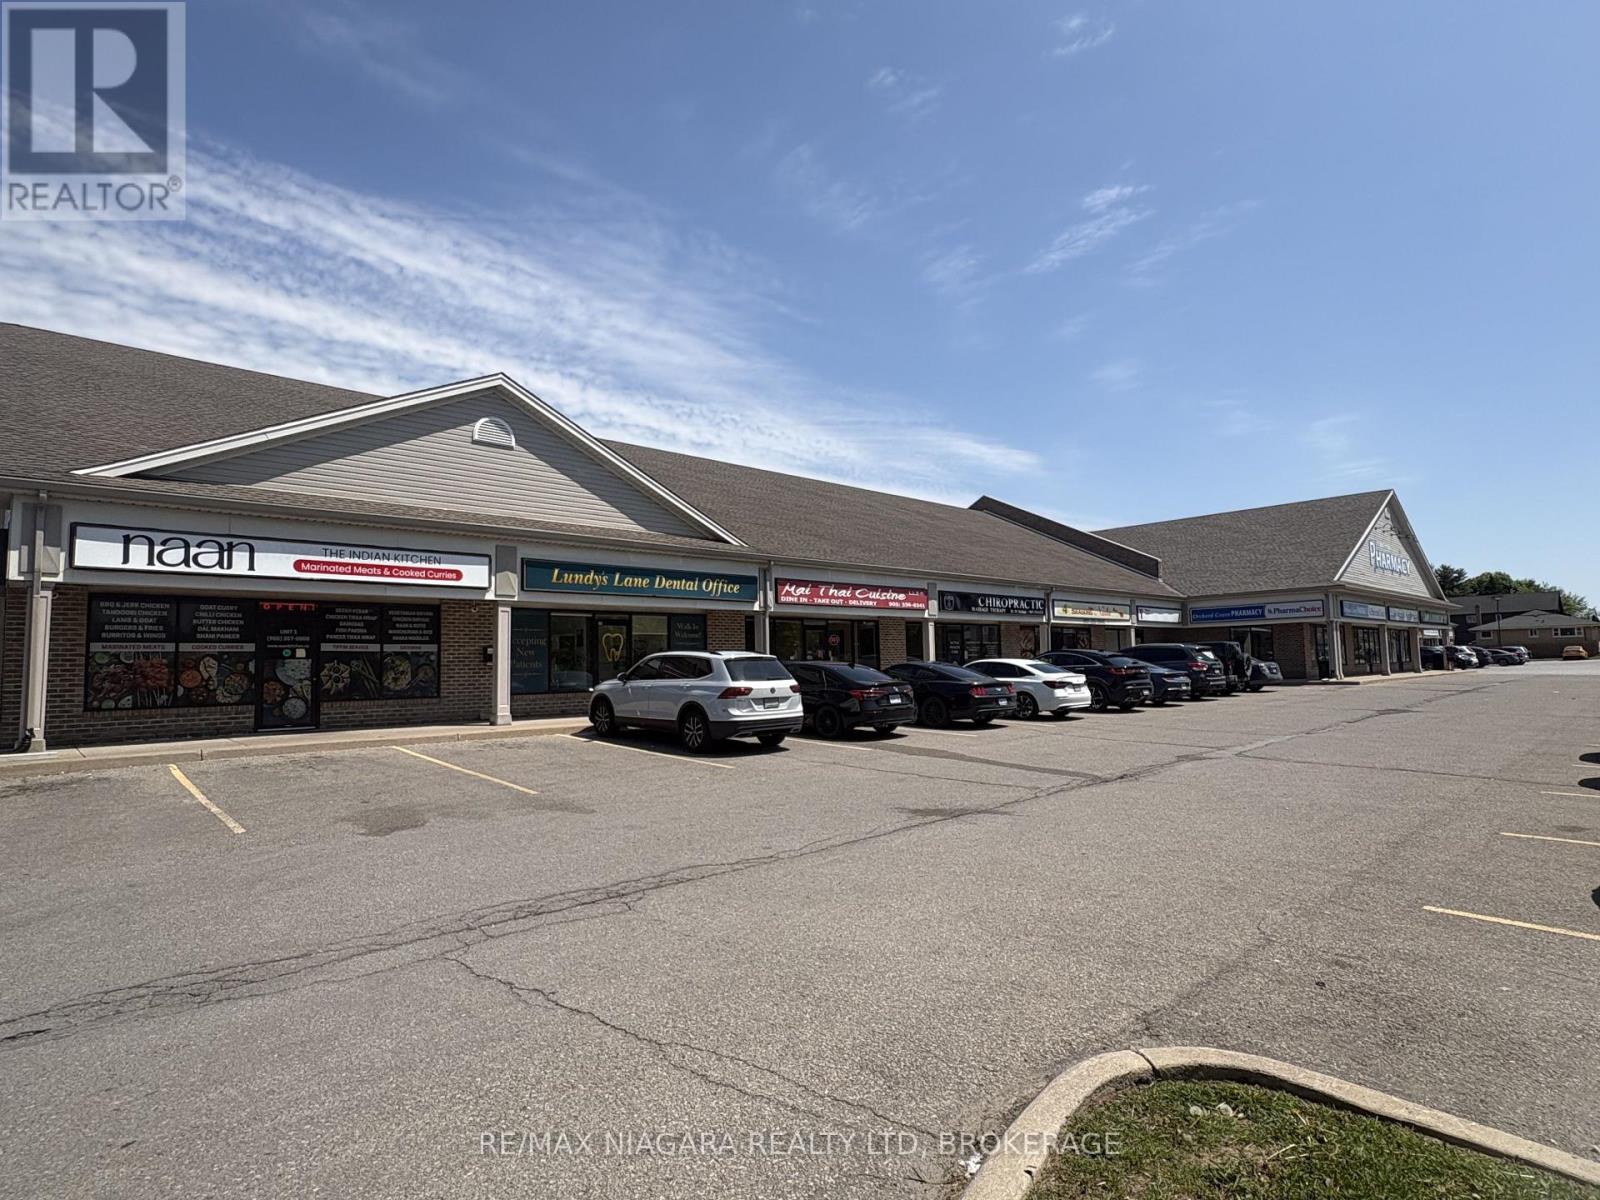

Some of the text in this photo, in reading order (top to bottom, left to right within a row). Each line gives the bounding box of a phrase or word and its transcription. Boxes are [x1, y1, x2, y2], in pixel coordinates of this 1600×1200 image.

[121, 533, 256, 572] naan
[322, 547, 442, 565] THE INDIAN KITCHEN
[1369, 541, 1410, 575] PHARMACY
[301, 562, 457, 580] Marinated Meats & Cooked Curries
[551, 568, 740, 597] Lundy's Lane Dental Office
[781, 582, 811, 596] Mai
[819, 584, 851, 598] Thai
[855, 587, 907, 601] Cuisine
[848, 599, 877, 607] DELIVERY
[978, 596, 1044, 610] CHIROPRACTIC
[1231, 608, 1263, 617] PHARMACY
